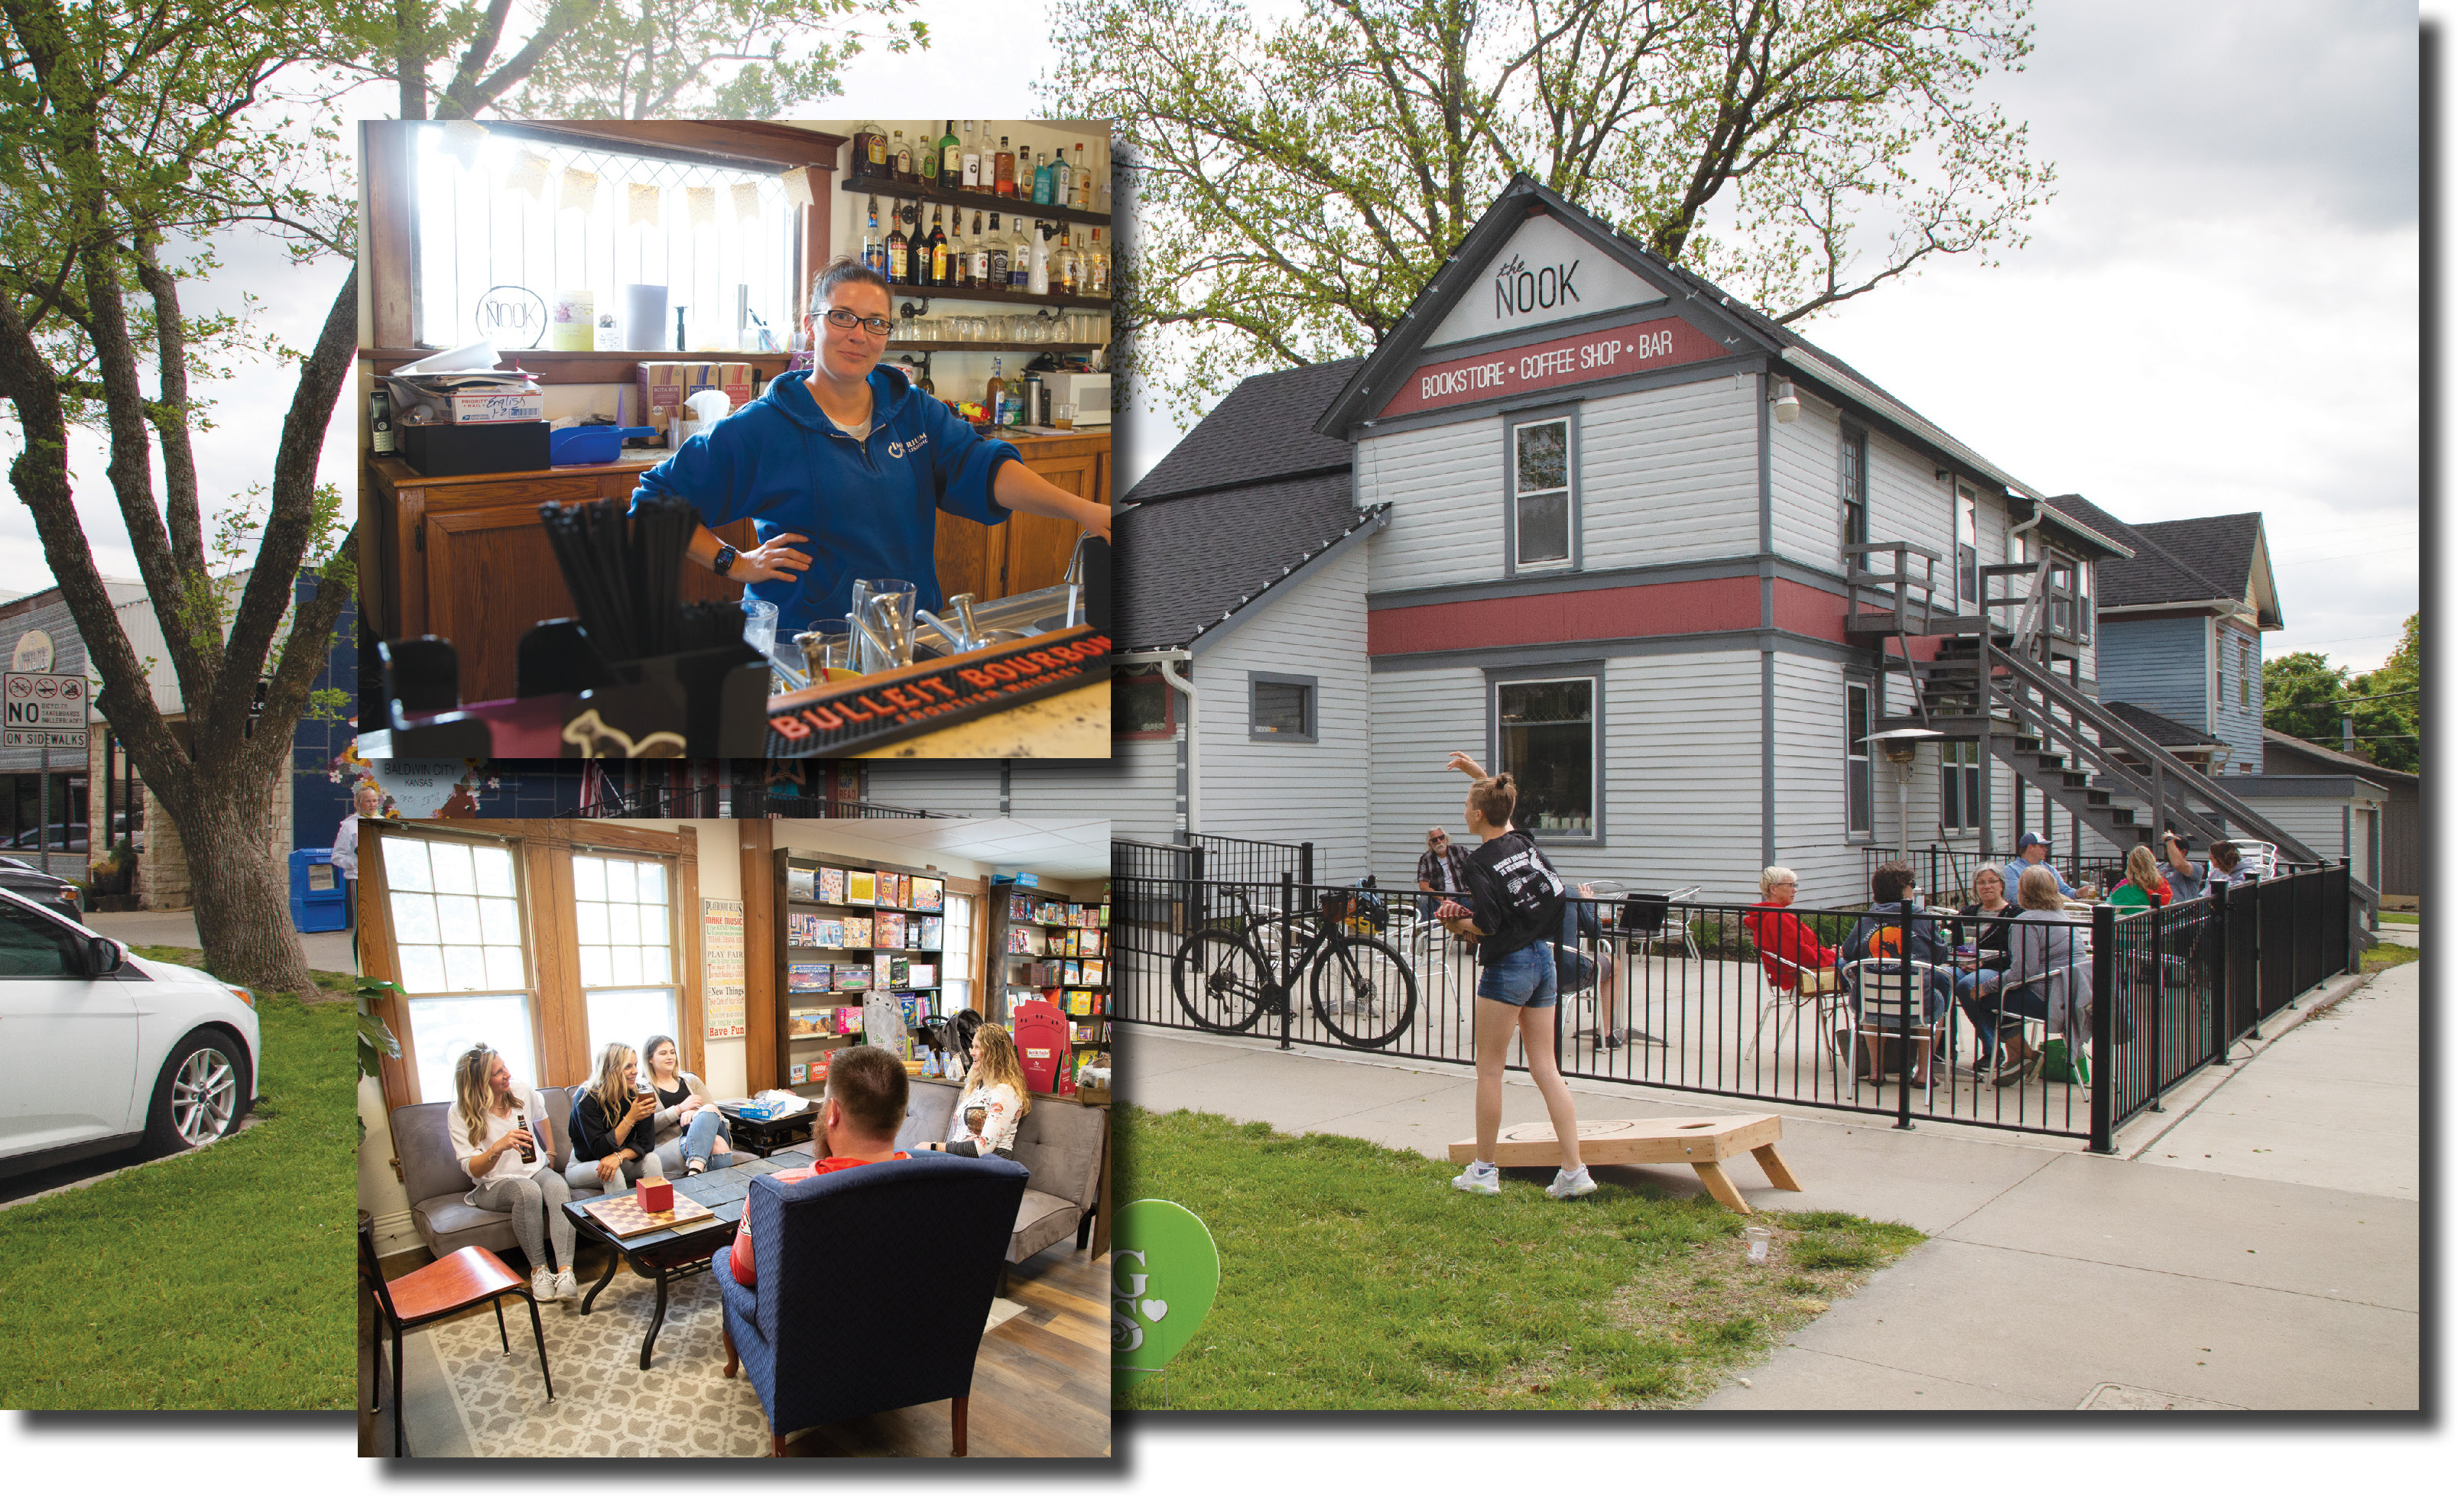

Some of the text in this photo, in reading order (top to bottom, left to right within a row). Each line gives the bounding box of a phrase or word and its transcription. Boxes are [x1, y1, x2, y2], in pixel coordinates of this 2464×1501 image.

[1496, 253, 1525, 277] the
[1495, 259, 1581, 319] NOOK
[486, 303, 538, 329] NOOK
[1421, 330, 1673, 400] BOOKSTORE COFFEE SHOP BAR
[769, 634, 1111, 740] BULLEIT BOURBON
[895, 666, 1083, 724] FRONTIER WHISKEY
[9, 702, 39, 723] NO
[7, 733, 84, 745] ON SIDEWALKS
[385, 763, 456, 776] BALDWIN CITY
[404, 779, 433, 787] KANSAS
[839, 789, 856, 799] READ
[706, 916, 742, 926] MAKE MUSIC
[712, 987, 745, 997] New Things
[709, 1026, 745, 1036] Have Fun
